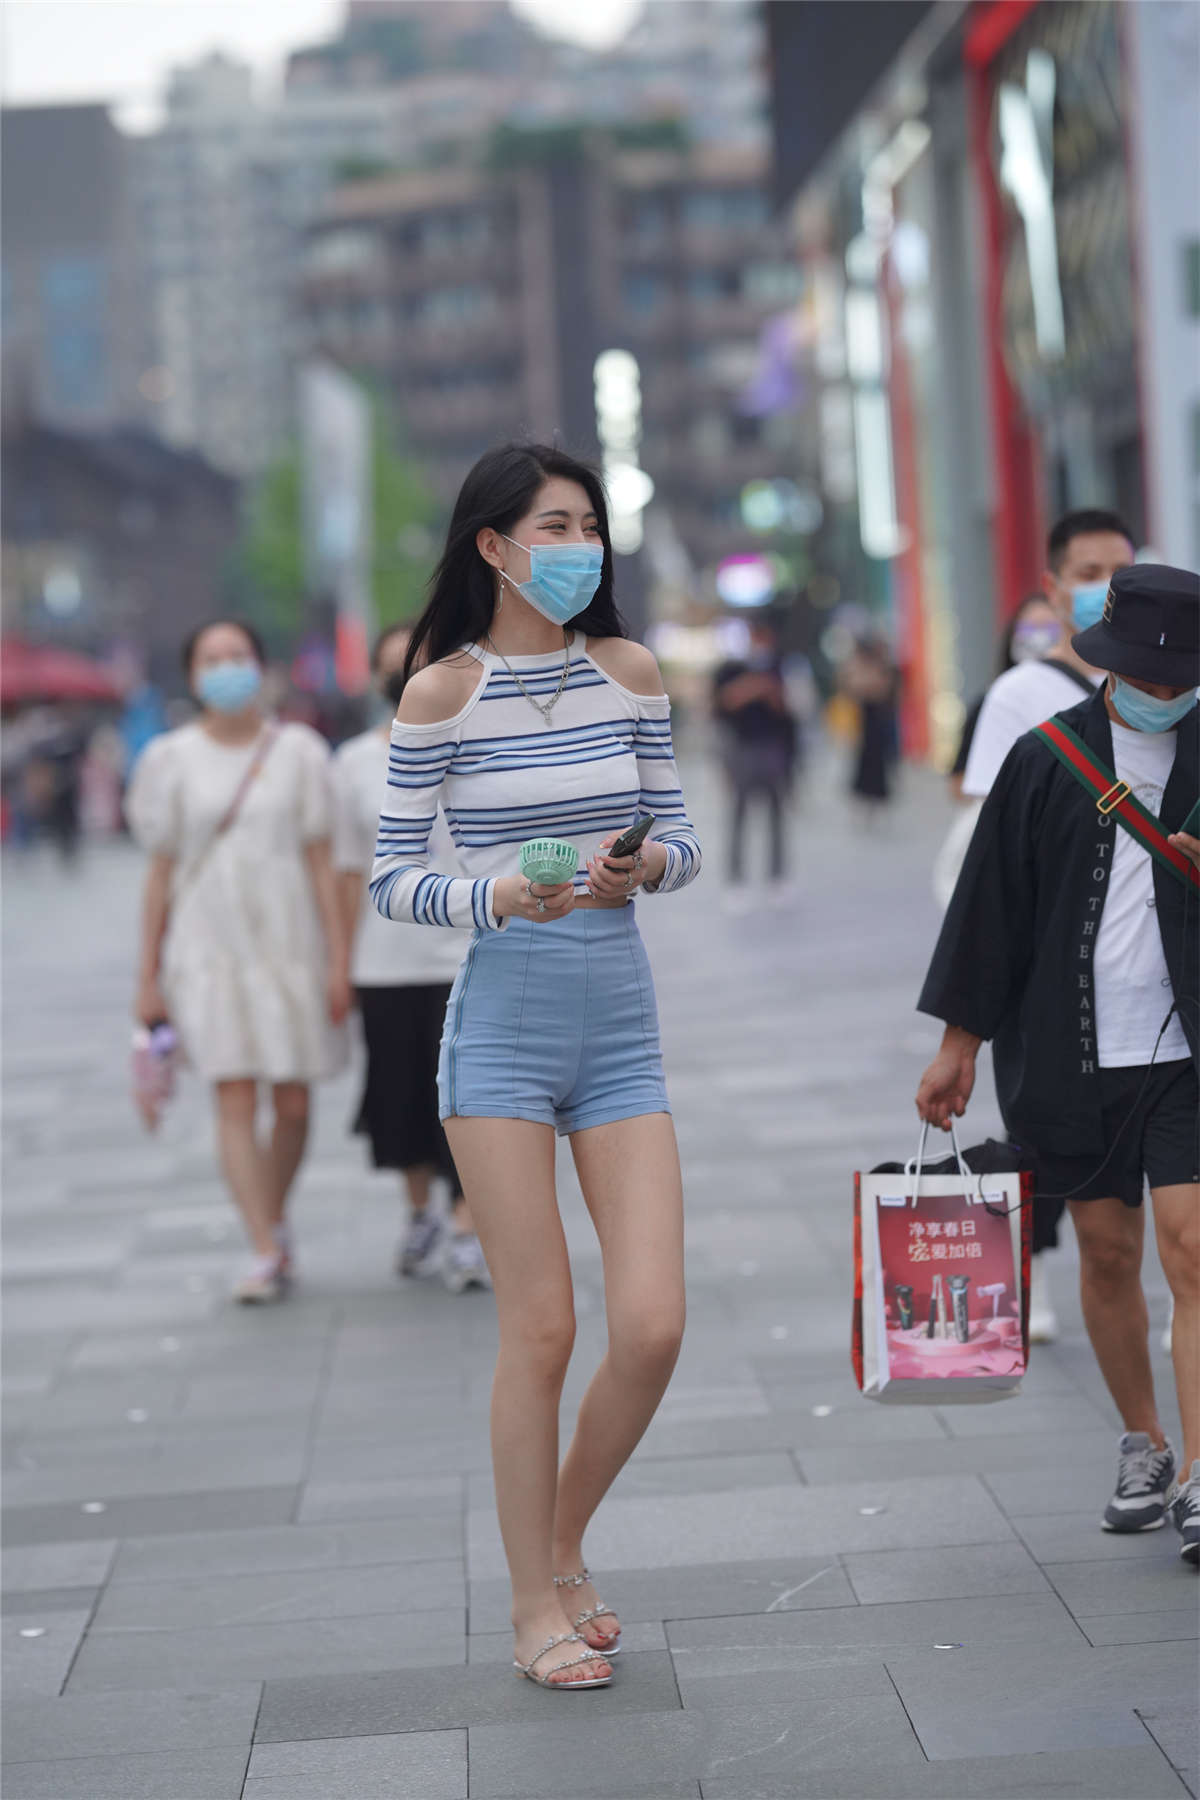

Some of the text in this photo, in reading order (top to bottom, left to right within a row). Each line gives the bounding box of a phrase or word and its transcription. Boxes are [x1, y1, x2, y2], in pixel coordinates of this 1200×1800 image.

[1092, 843, 1110, 882] TO
[1079, 896, 1101, 960] THE
[1079, 974, 1094, 1074] EARTH
[908, 1220, 976, 1238] 净享春日
